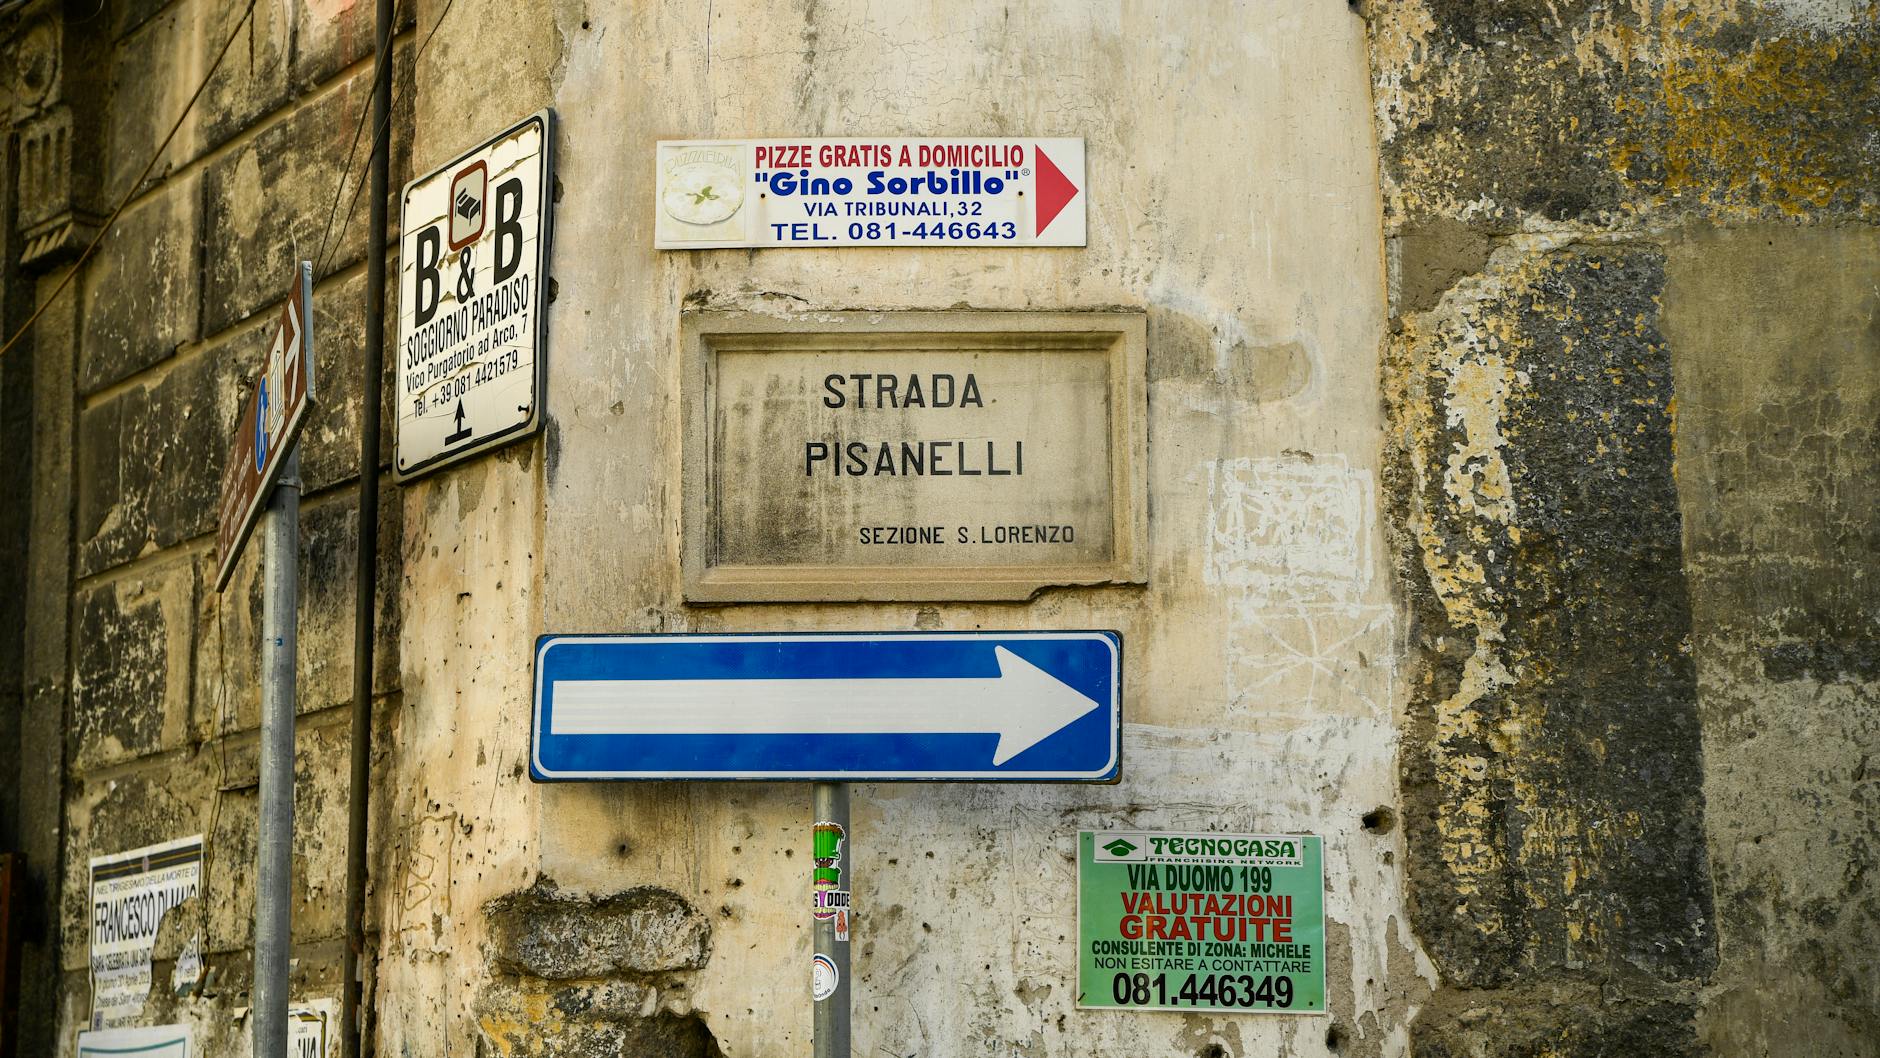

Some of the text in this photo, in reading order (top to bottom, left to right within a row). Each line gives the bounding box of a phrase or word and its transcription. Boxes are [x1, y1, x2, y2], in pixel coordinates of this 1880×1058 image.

[755, 144, 1024, 169] PIZZE GRATIS A DOMICILIO
[755, 169, 854, 196] "Gino
[804, 201, 982, 218] VIA TRIBUNALI,32
[771, 222, 1016, 241] TEL. 081-446643
[415, 177, 523, 329] B & B
[407, 273, 529, 370] SOGGIORNO PARADISO
[406, 313, 528, 393] Vico Purgatorio ad Arco, 7
[413, 349, 518, 418] Tel. +39 081 4421579
[823, 374, 984, 409] STRADA
[805, 441, 1022, 477] PISANELLI
[860, 526, 944, 544] SEZIONE
[1149, 837, 1296, 858] TECNOCASA
[1127, 864, 1272, 893] VIA DUOMO 199
[1121, 892, 1292, 918] VALUTAZIONI
[1119, 915, 1293, 943] GRATUITE
[1092, 940, 1311, 960] CONSULENTE DI ZONA: MICHELE
[1094, 957, 1311, 973] NON ESITARE A CONTATTARE
[1113, 972, 1293, 1008] 081.446349
